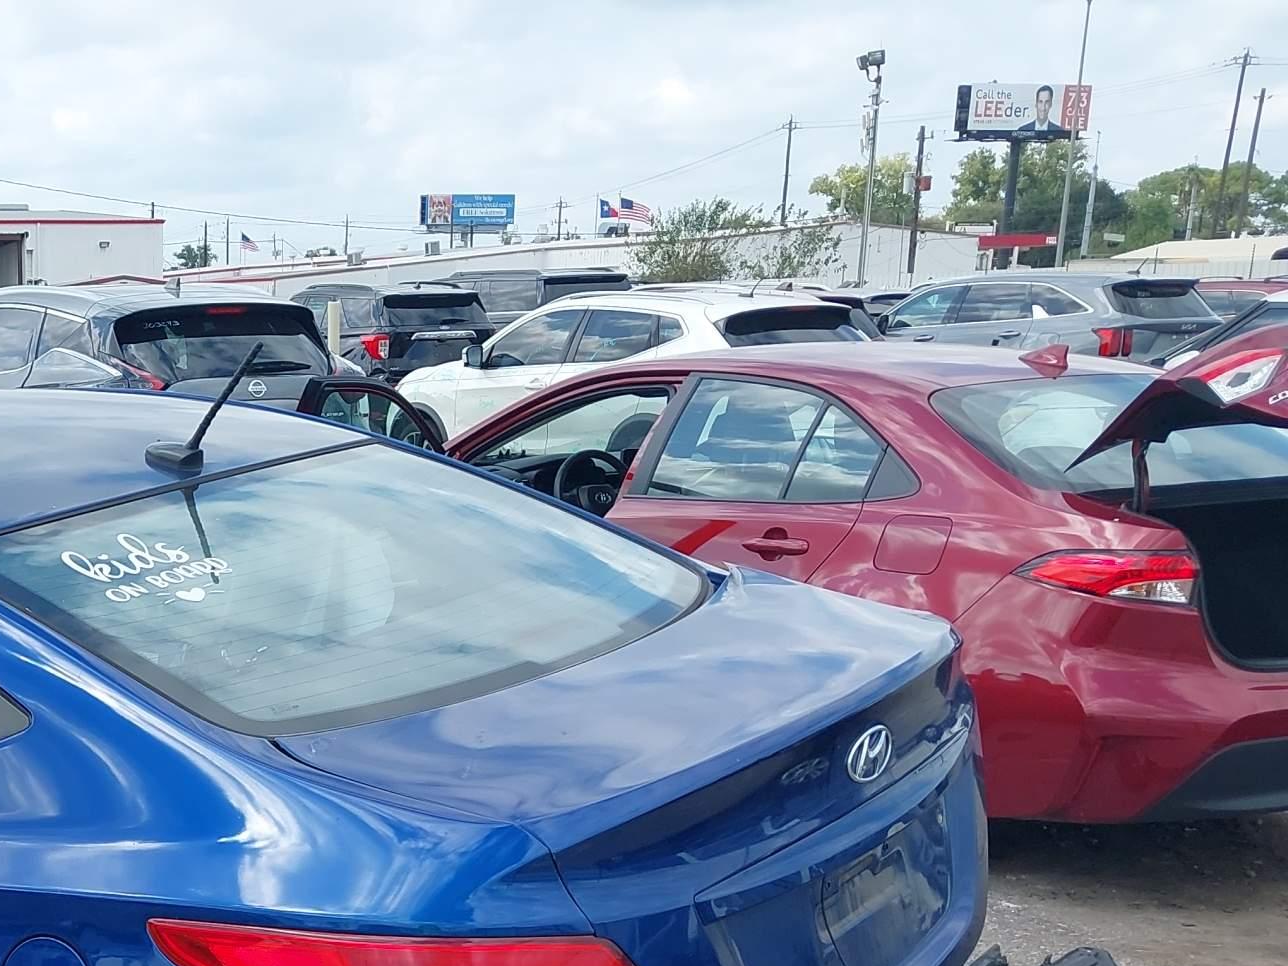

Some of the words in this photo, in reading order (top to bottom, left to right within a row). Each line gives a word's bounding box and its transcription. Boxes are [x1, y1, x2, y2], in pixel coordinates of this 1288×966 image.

[976, 88, 995, 100] Call
[997, 88, 1012, 100] the
[1067, 92, 1089, 108] 73
[974, 100, 1031, 118] LEEder.
[60, 533, 190, 582] kids
[104, 582, 150, 604] ON
[145, 557, 233, 589] BOARD
